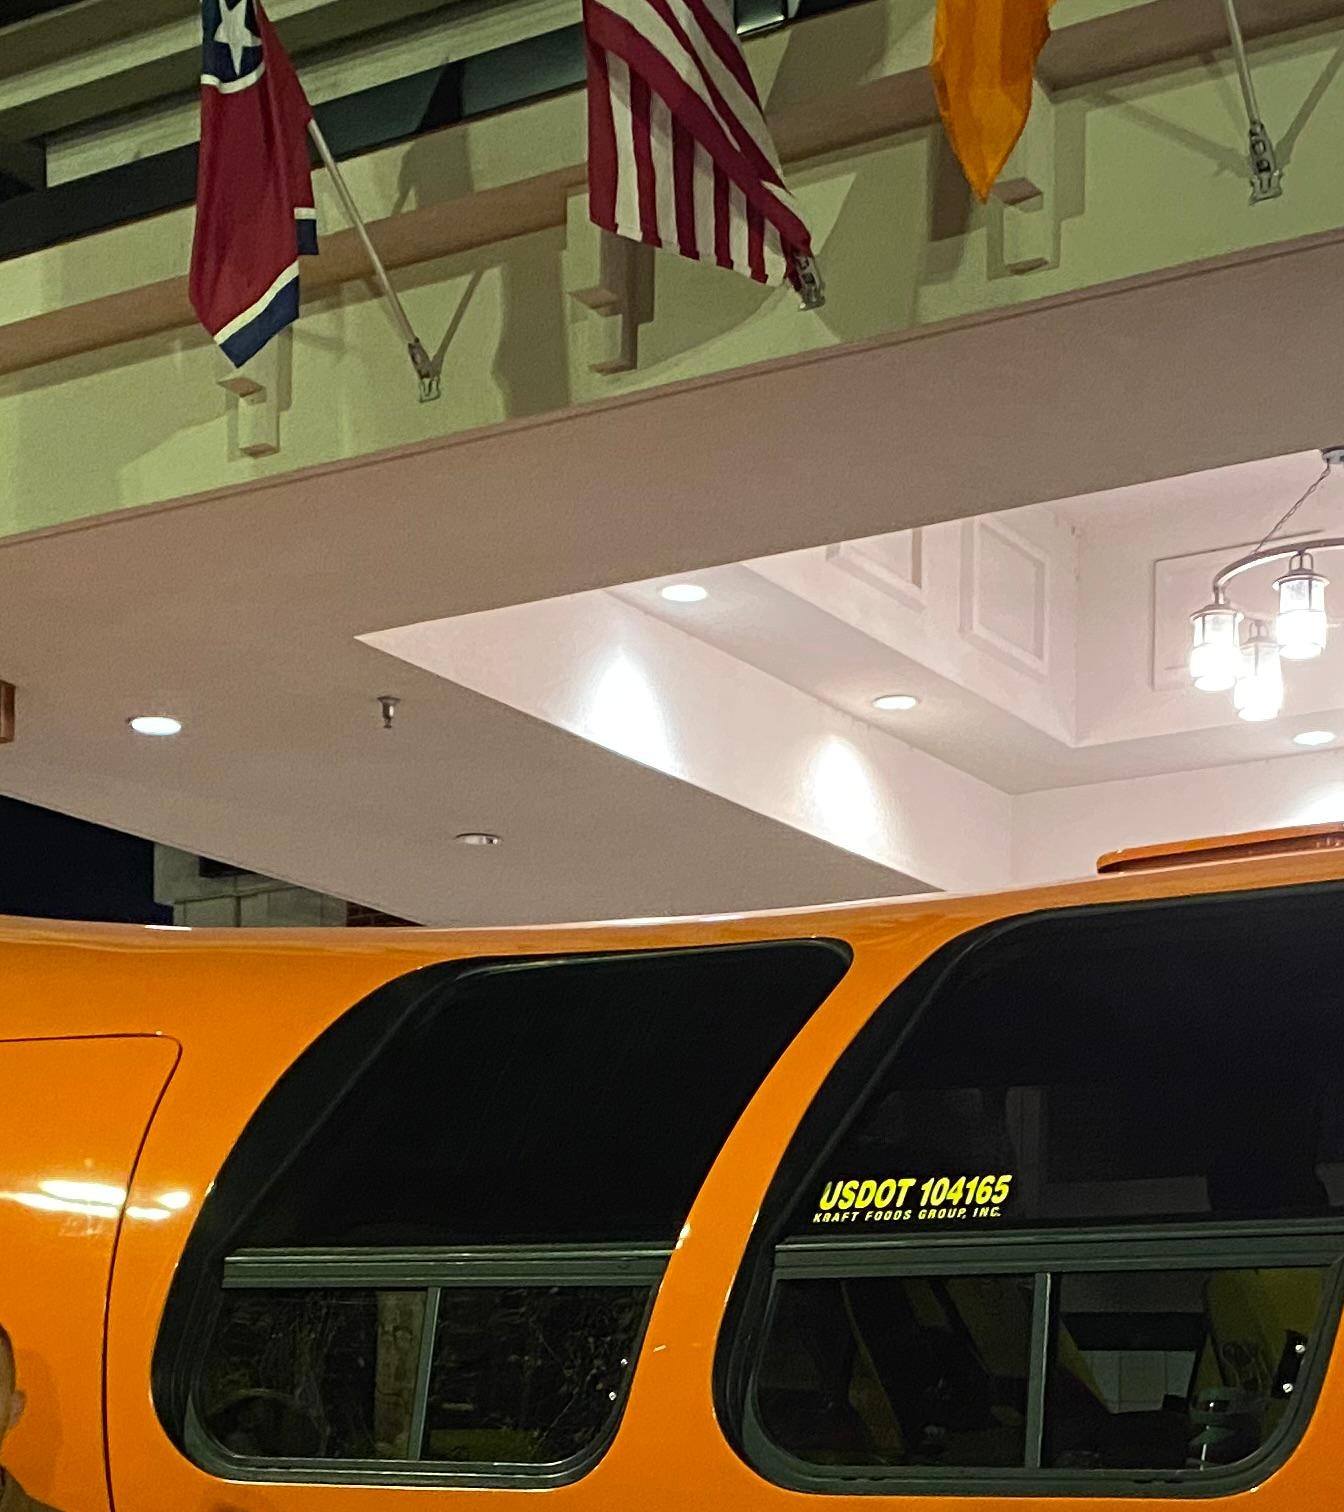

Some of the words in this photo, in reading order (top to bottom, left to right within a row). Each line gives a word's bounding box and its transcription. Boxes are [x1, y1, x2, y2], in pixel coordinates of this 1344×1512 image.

[819, 1178, 916, 1210] USDOT
[920, 1175, 1012, 1207] 104165
[813, 1211, 859, 1223] KRAFT
[864, 1209, 912, 1222] FOODS
[918, 1208, 966, 1220] GROUP,
[972, 1206, 1001, 1217] INC.
